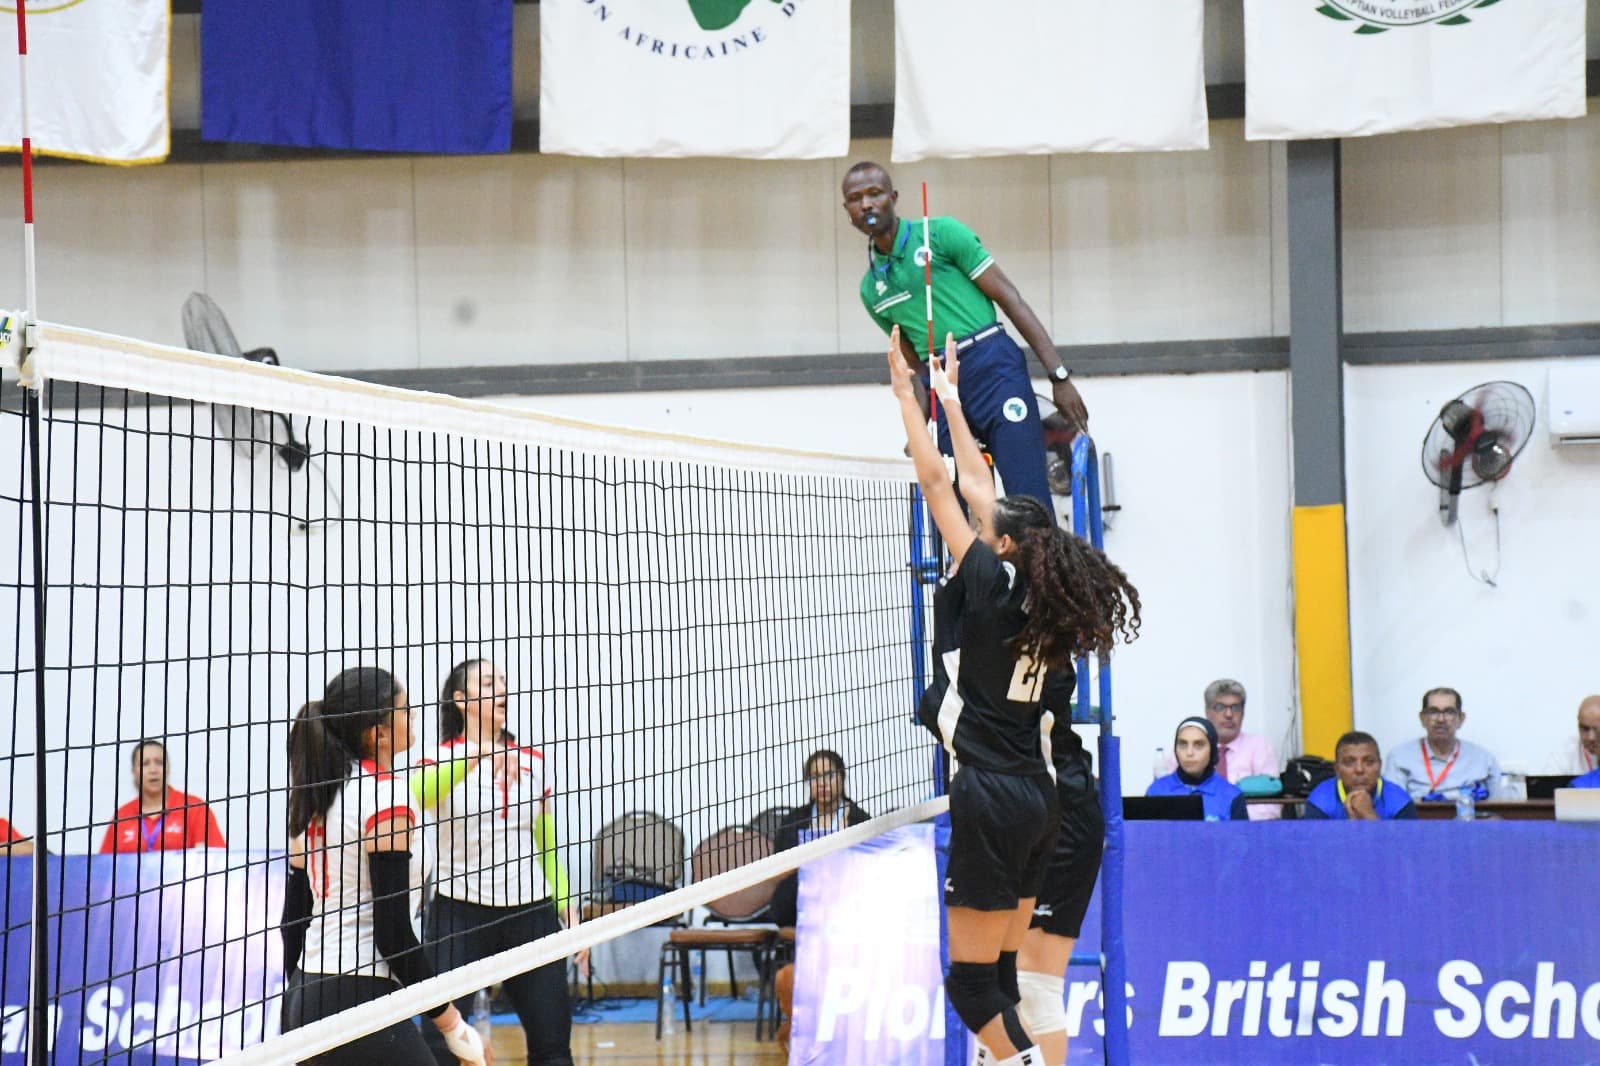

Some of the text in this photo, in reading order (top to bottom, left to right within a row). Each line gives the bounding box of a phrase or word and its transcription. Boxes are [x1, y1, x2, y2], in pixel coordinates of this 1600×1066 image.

[1379, 4, 1435, 19] VOLLEYBALL
[618, 26, 767, 59] AFRICAINE
[1158, 960, 1407, 1039] British
